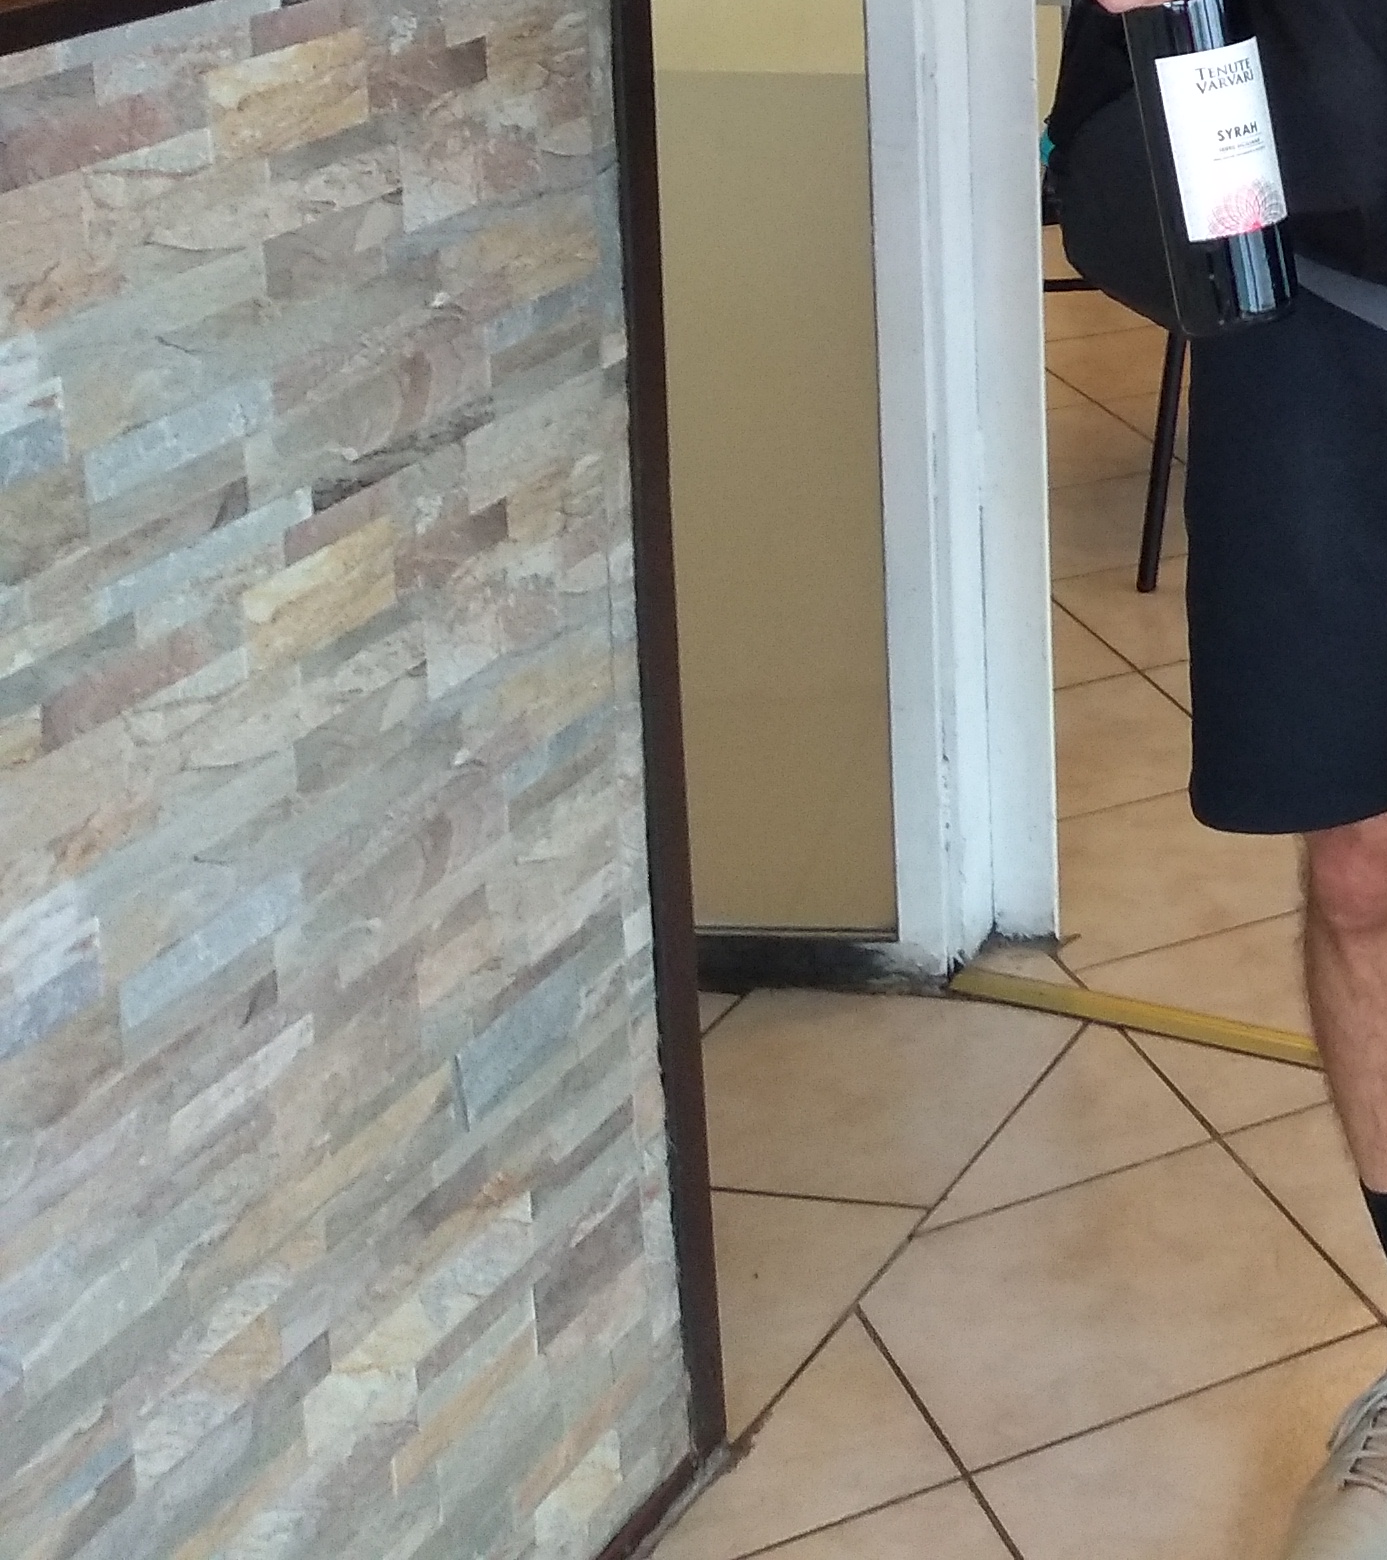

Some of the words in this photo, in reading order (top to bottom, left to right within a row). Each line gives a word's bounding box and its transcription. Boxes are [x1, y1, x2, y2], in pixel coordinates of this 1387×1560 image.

[1195, 57, 1251, 81] TENUTE
[1196, 69, 1255, 95] VARVARI
[1217, 121, 1259, 142] SYRAH
